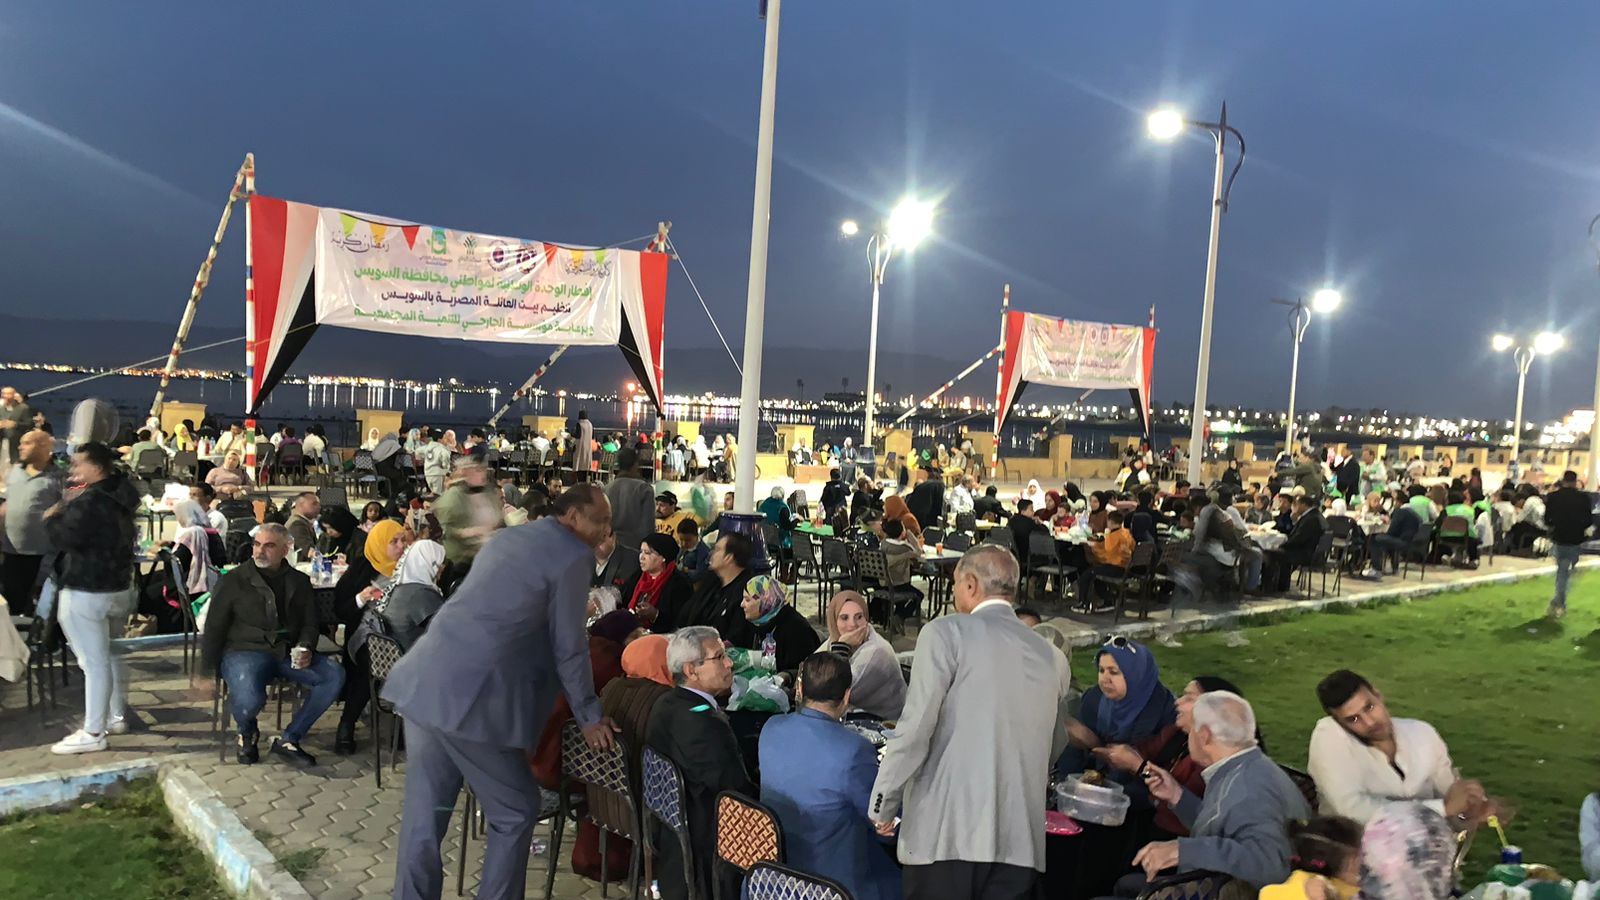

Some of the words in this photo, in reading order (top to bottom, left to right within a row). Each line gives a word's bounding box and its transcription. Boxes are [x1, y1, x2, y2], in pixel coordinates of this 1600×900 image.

[354, 266, 400, 280] السويس
[450, 273, 494, 291] لمواطني
[535, 280, 566, 297] الوحدة
[381, 290, 434, 305] بالسويس
[436, 291, 481, 307] المصرية
[483, 296, 517, 309] العائلة
[354, 304, 416, 323] المجتمعية
[518, 300, 538, 314] بيت
[541, 302, 571, 315] تنظيم
[418, 310, 460, 326] للتنمية
